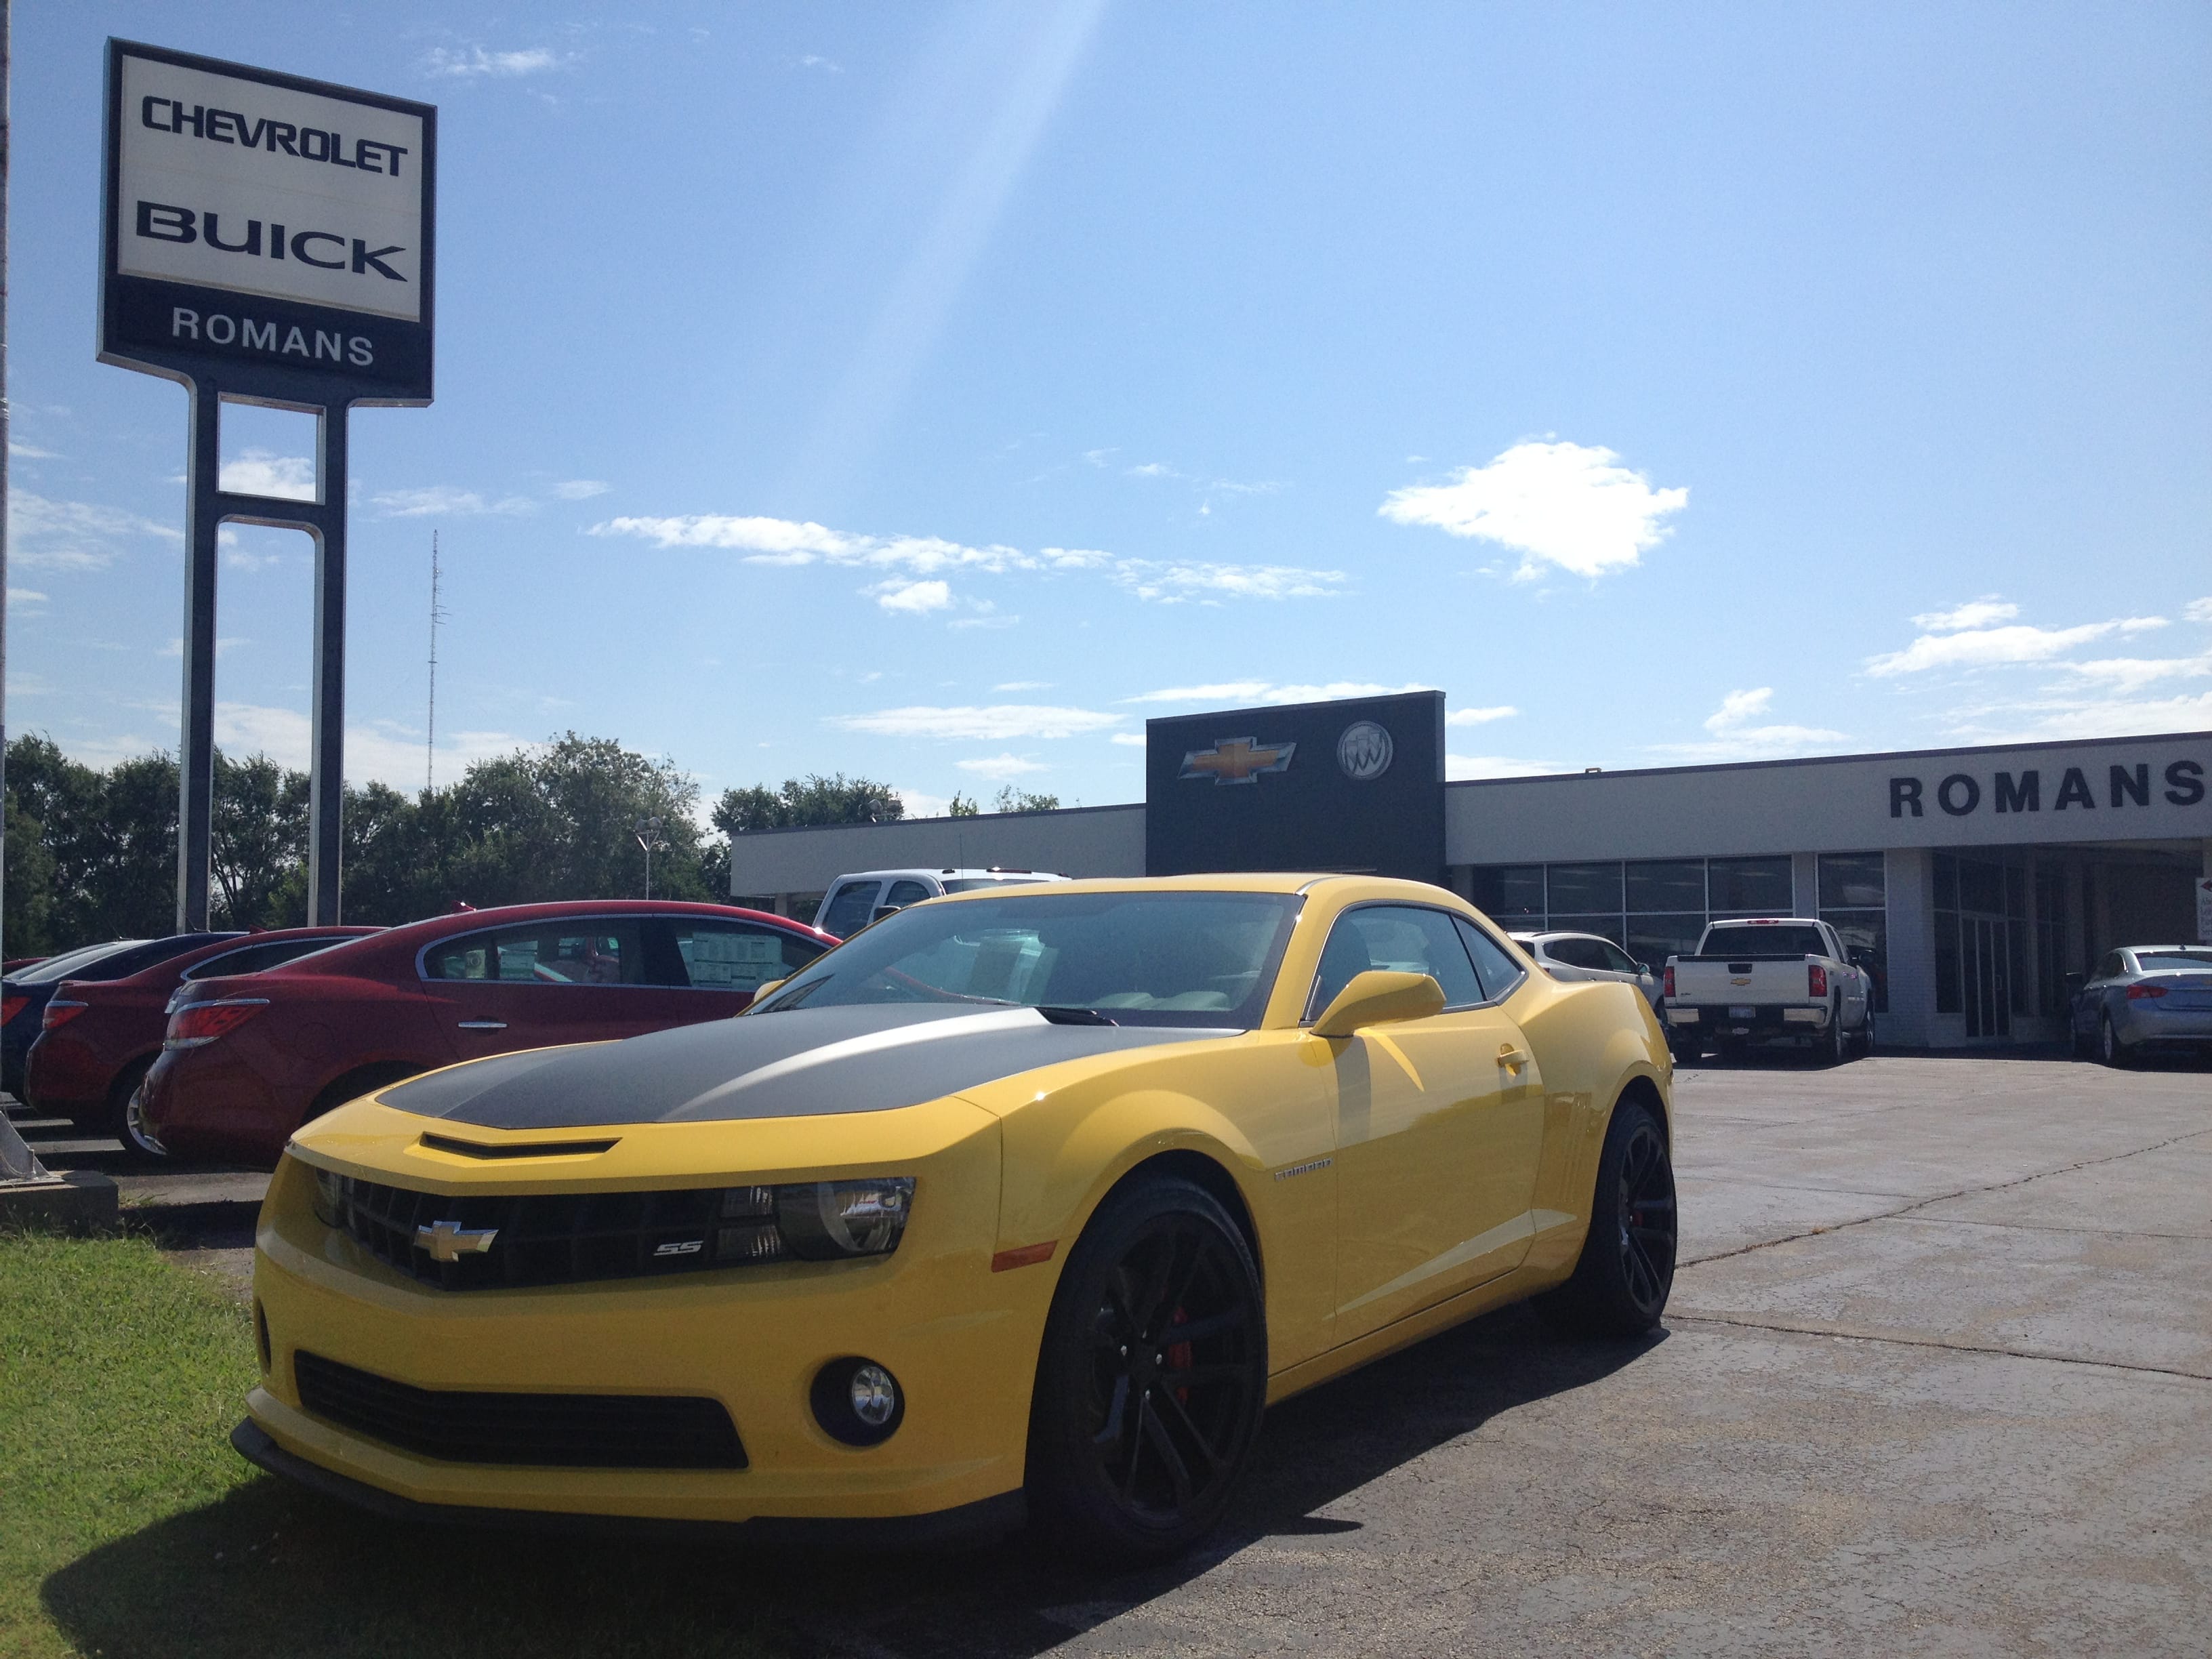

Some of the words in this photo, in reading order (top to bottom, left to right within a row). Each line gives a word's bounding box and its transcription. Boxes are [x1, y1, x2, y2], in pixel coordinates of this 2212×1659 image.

[142, 96, 408, 176] CHEVROLET
[136, 201, 408, 282] BUICK
[172, 307, 373, 366] ROMANS
[1889, 760, 2205, 818] ROMANS
[653, 1240, 703, 1256] SS
